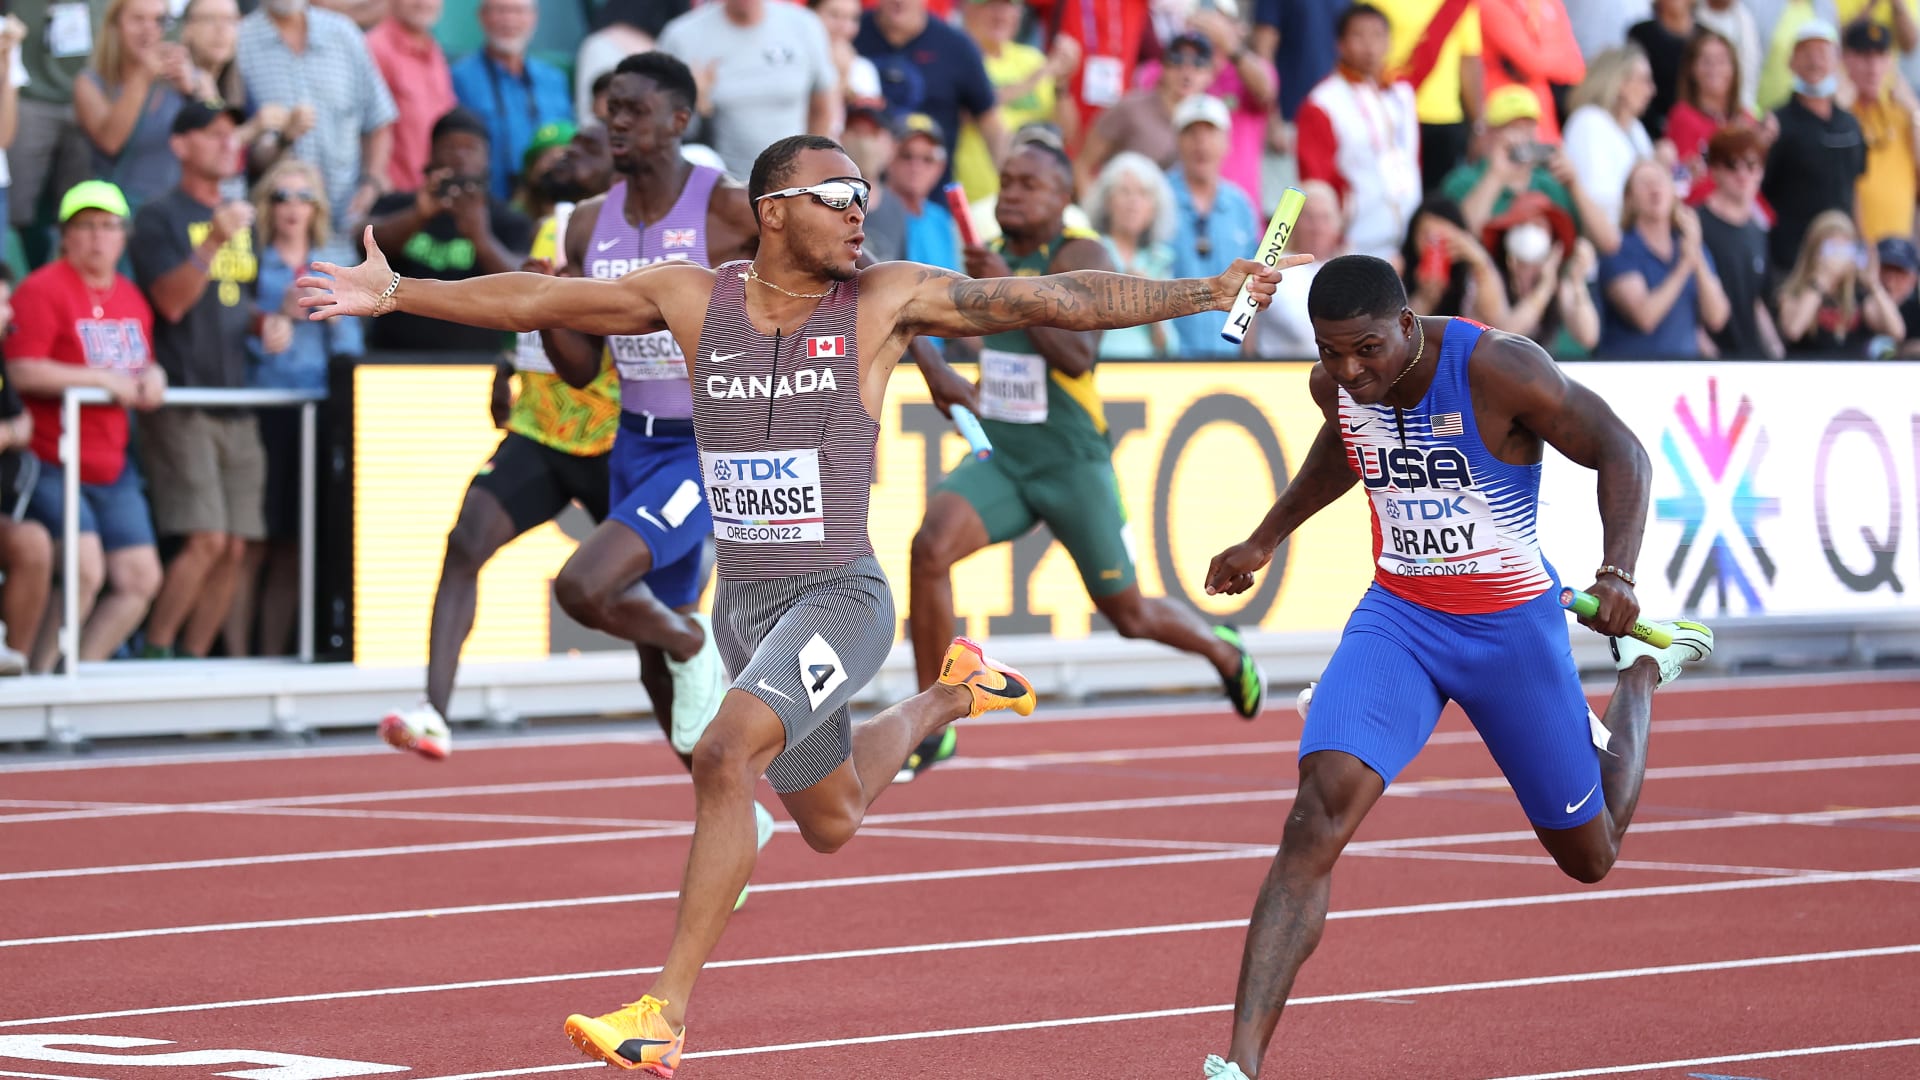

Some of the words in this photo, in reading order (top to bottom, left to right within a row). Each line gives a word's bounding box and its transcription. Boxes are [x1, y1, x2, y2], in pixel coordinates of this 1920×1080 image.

[1234, 313, 1251, 334] 4
[707, 367, 837, 399] CANADA
[729, 457, 799, 481] TDK
[1354, 446, 1475, 491] USA
[711, 487, 733, 514] DE
[735, 486, 816, 516] GRASSE
[1397, 495, 1471, 521] TDK
[1813, 407, 1920, 594] Q
[726, 526, 802, 541] OREGON22
[1391, 522, 1476, 555] BRACY
[1396, 560, 1480, 577] OREGON22
[808, 664, 836, 694] 4
